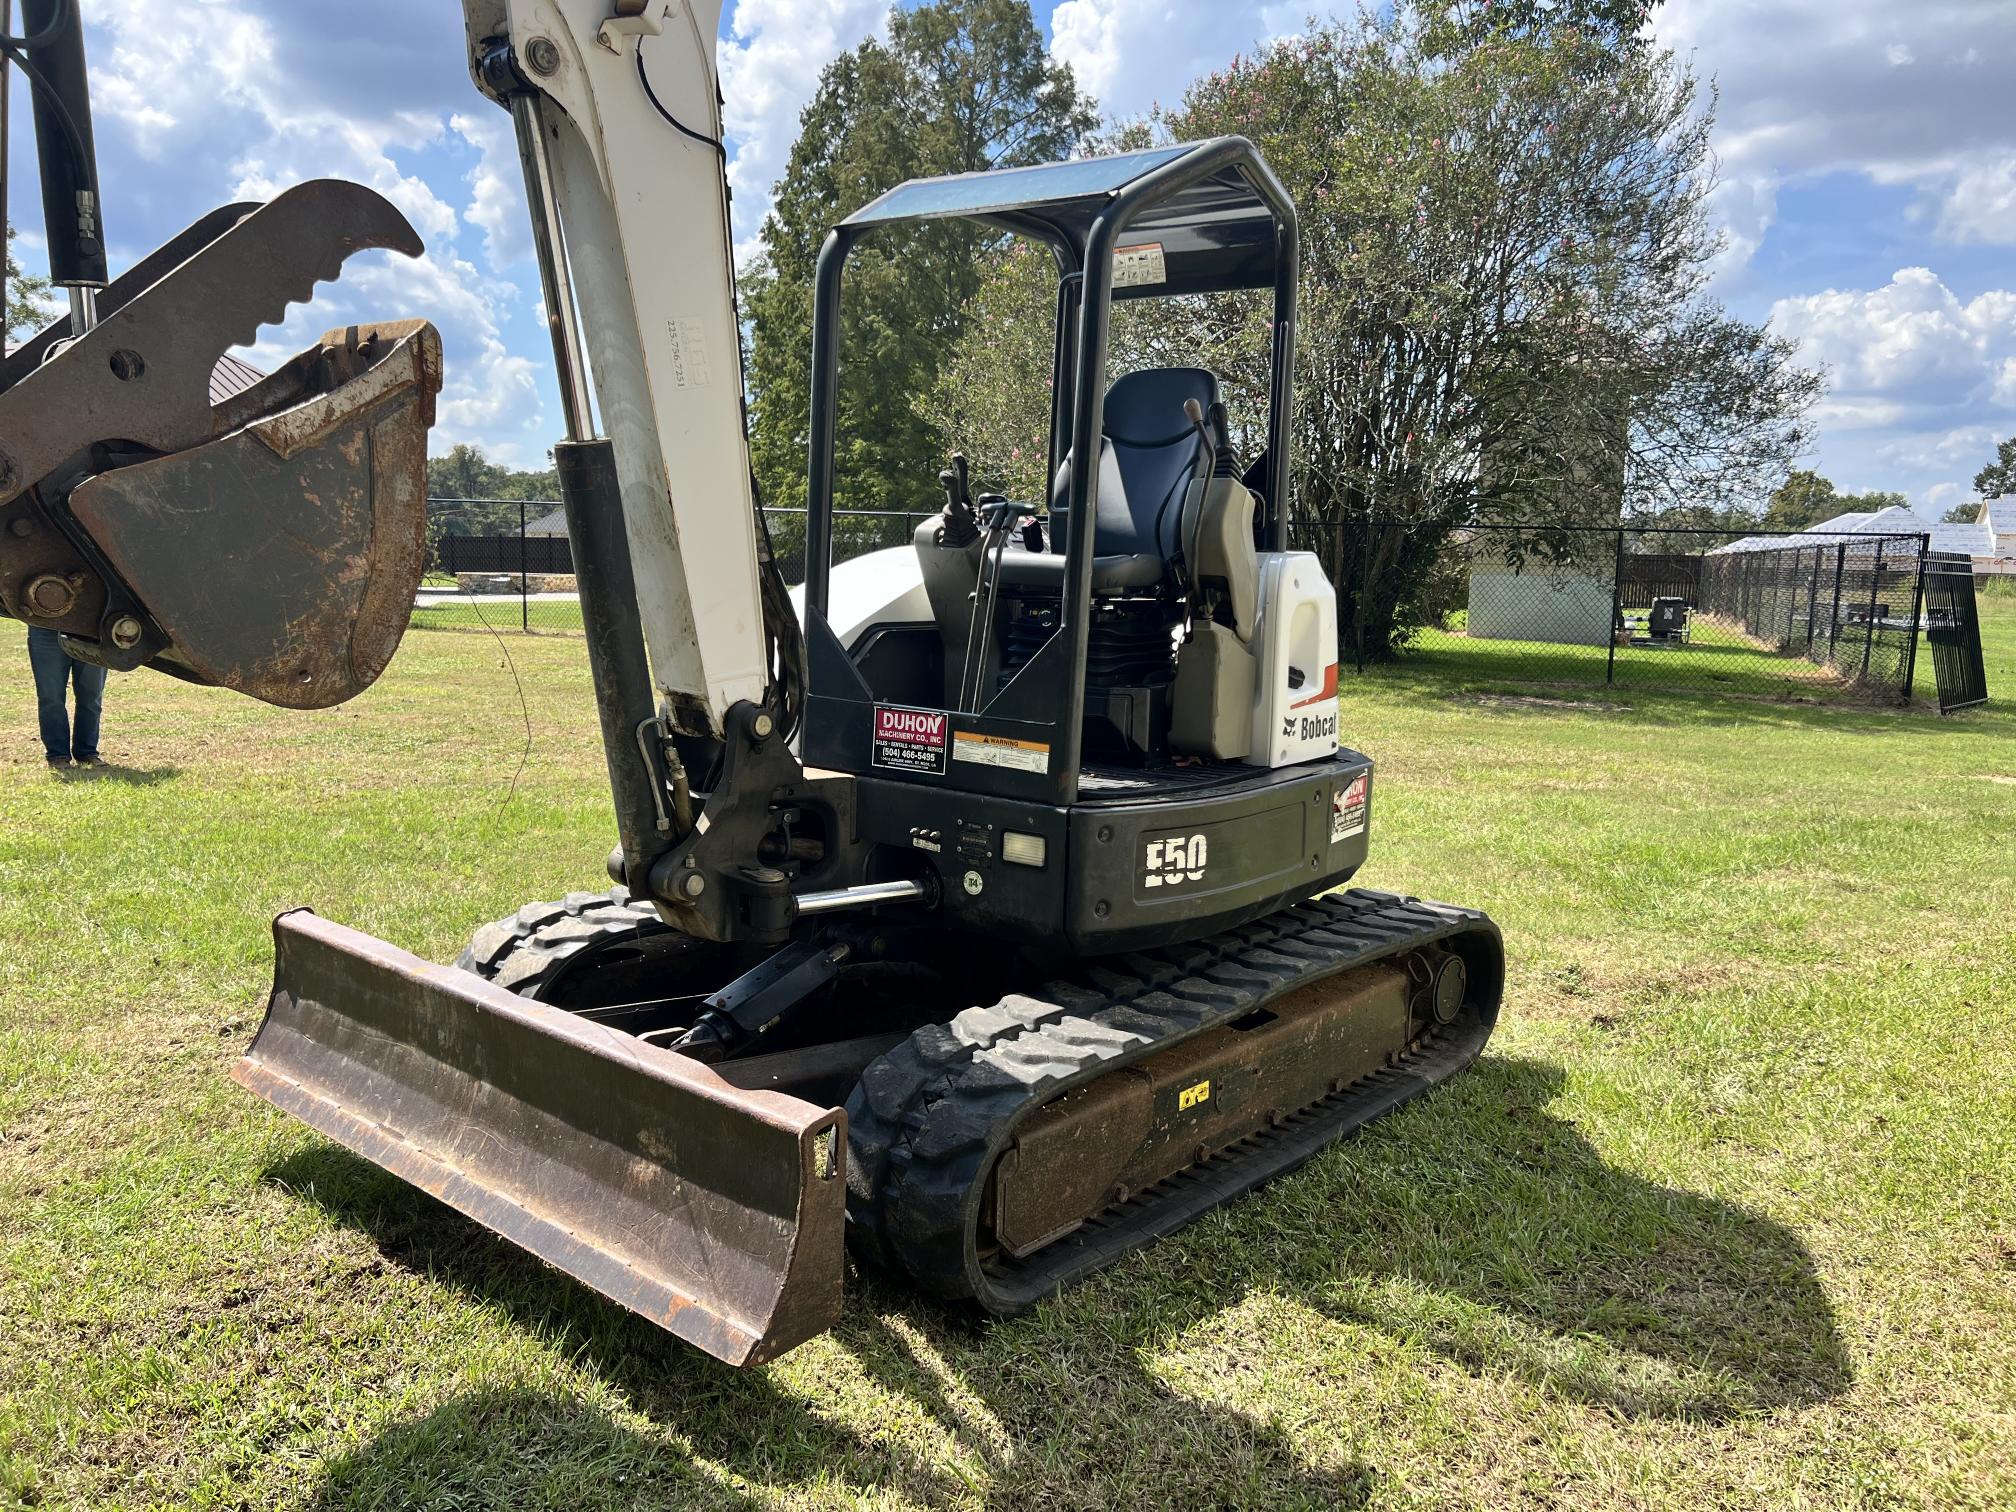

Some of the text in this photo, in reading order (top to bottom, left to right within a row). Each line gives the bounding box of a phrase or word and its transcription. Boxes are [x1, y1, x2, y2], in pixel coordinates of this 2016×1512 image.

[883, 712, 940, 734] DUHON
[879, 730, 915, 740] MACHINERY
[990, 738, 1019, 747] WARNING
[883, 747, 900, 758] (504)
[902, 750, 935, 762] 466-5495
[1145, 834, 1207, 888] E50
